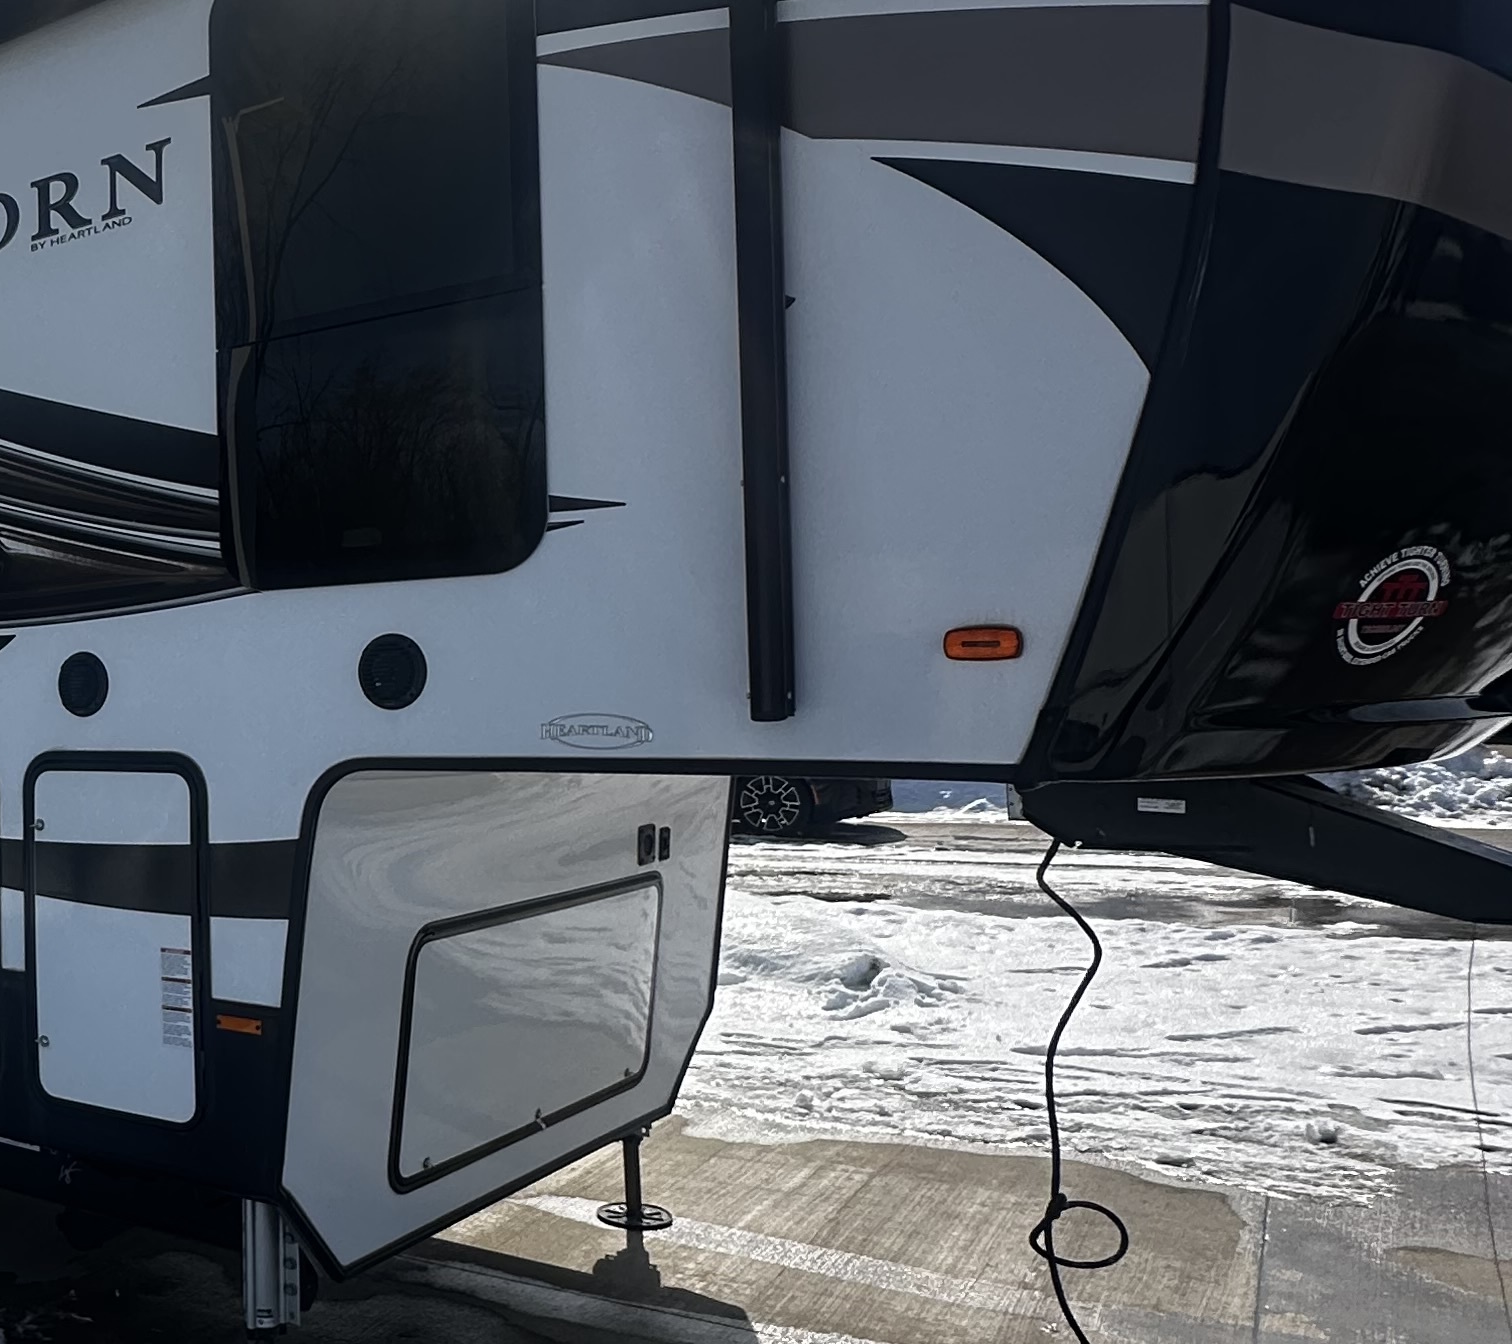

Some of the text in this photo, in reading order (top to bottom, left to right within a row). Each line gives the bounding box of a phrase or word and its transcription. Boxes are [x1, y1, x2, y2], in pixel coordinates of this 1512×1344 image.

[30, 216, 133, 252] BY HEARTLAND
[1359, 552, 1399, 588] ACHIEVE
[1340, 601, 1443, 618] TIGHT TURN
[540, 723, 653, 743] HEARTLAND
